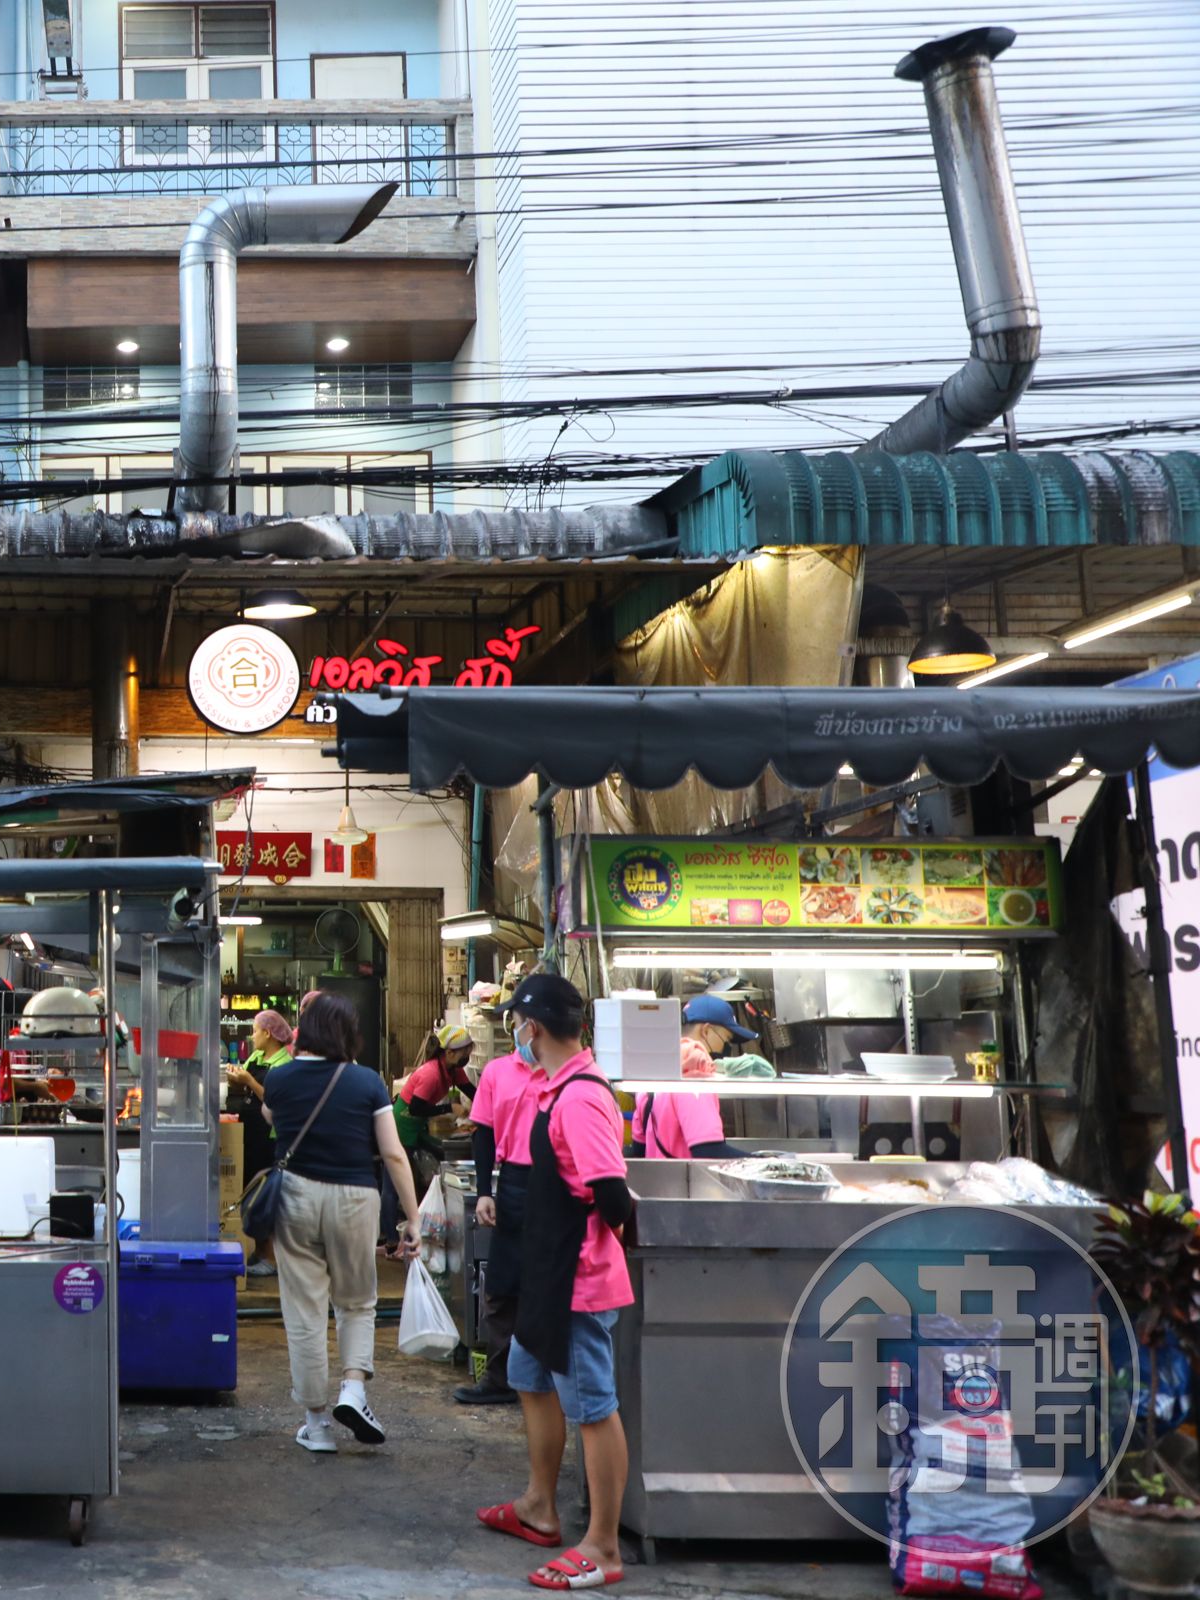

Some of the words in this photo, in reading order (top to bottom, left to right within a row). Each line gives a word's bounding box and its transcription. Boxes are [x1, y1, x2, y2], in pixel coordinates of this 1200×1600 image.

[229, 656, 259, 689] 合
[456, 625, 542, 688] สกี้
[192, 678, 239, 728] ELVISSUKI
[243, 719, 253, 729] &
[256, 675, 297, 725] SEAFOOD
